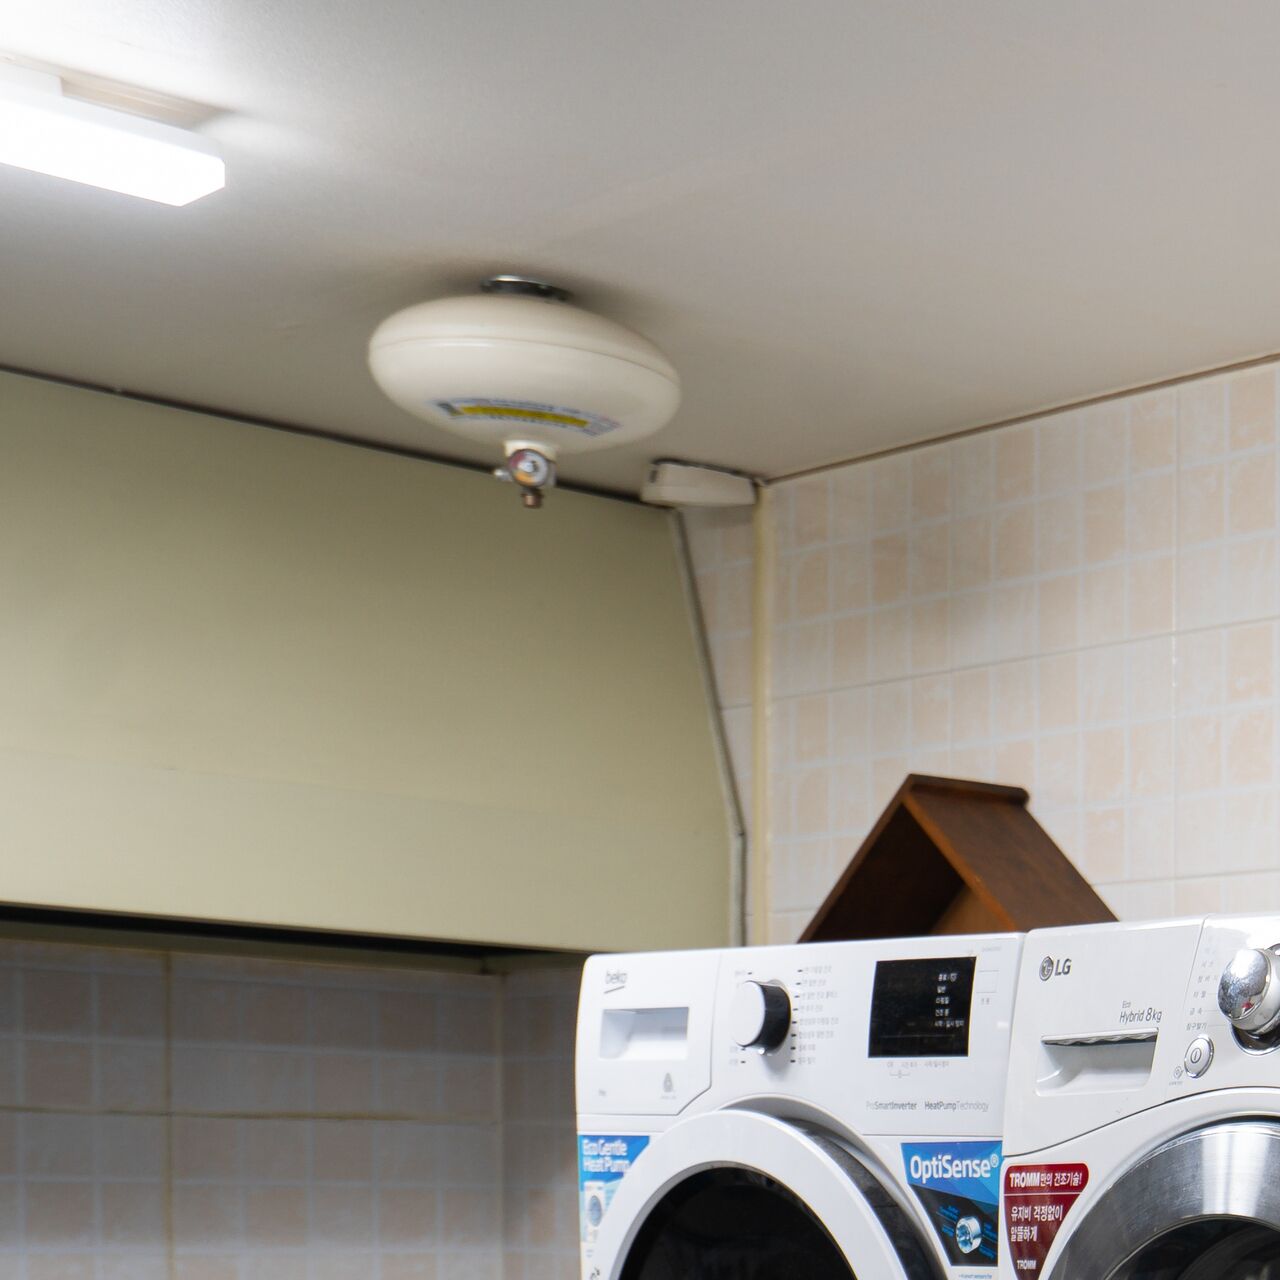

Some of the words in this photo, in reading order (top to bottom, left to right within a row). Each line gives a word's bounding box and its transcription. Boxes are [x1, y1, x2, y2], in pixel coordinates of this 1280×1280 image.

[1054, 958, 1072, 976] LG
[604, 971, 628, 985] beko
[1119, 1010, 1145, 1024] Hybrid
[1011, 1205, 1032, 1222] 유지비
[1033, 1204, 1064, 1222] 걱정없이
[1011, 1226, 1038, 1242] 알뜰하게
[1017, 1260, 1037, 1270] TROMM
